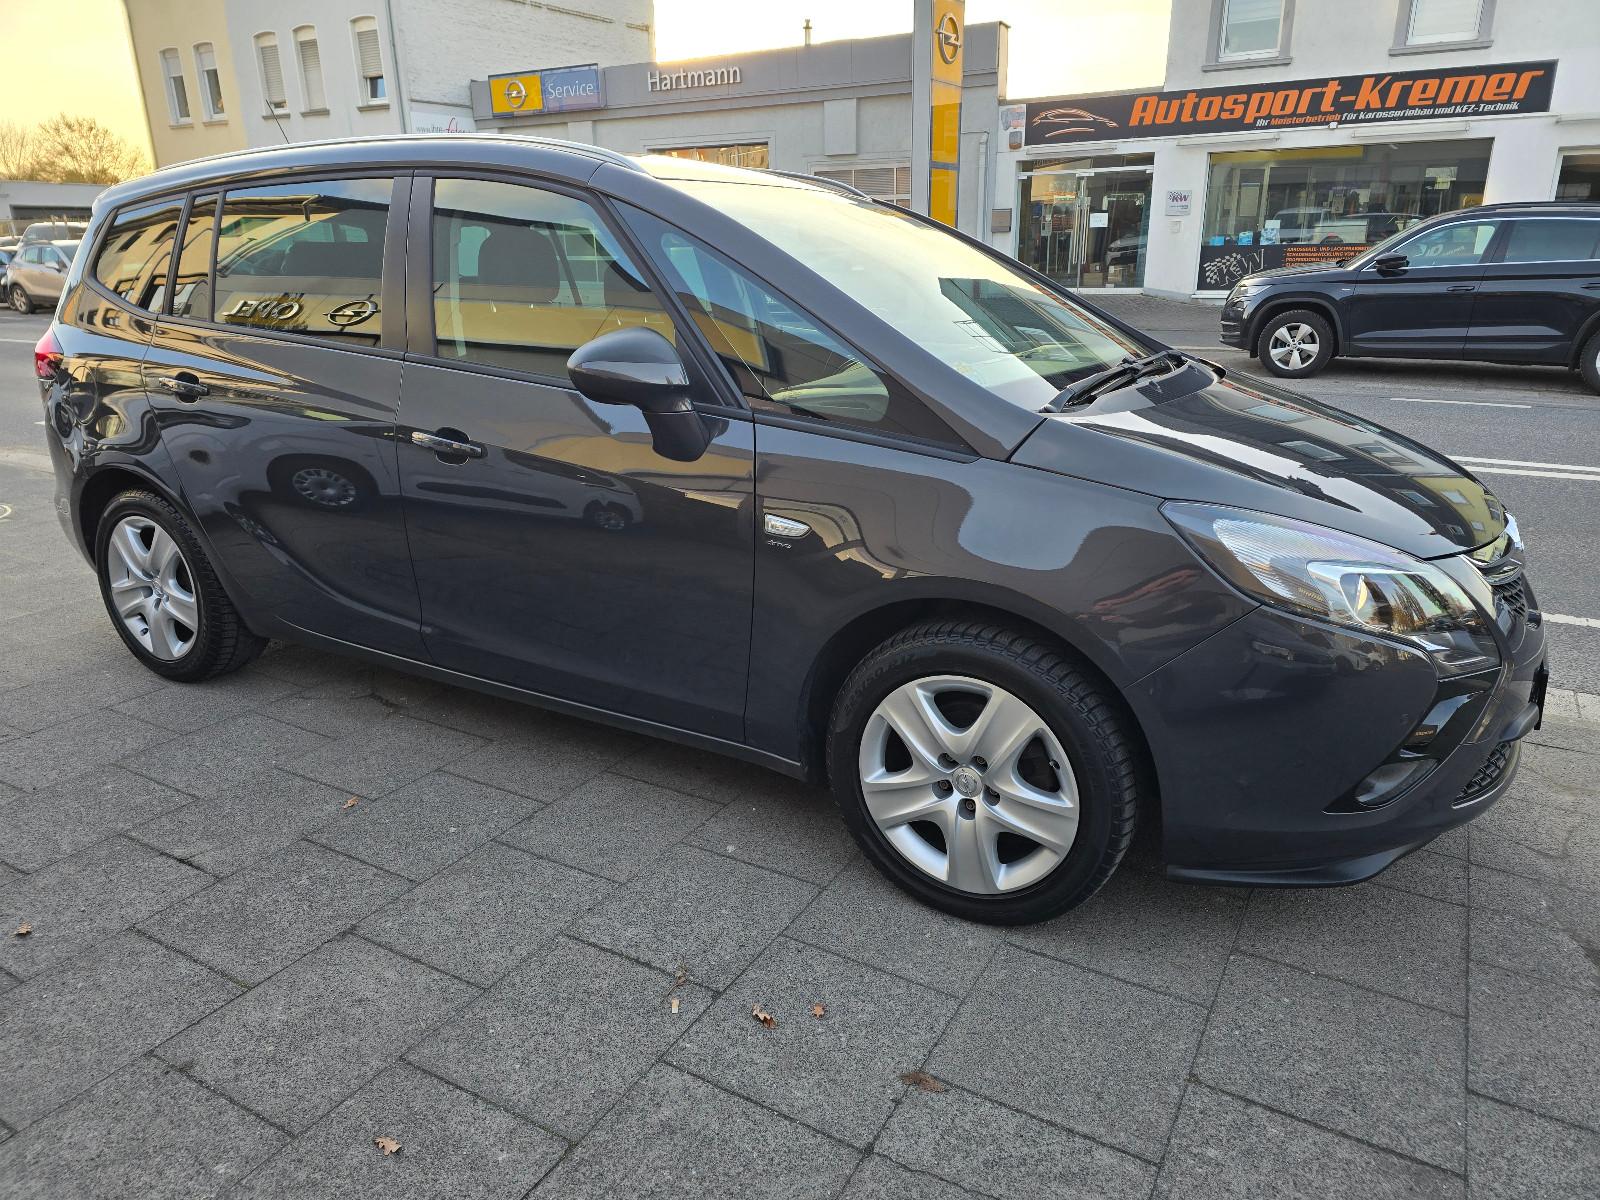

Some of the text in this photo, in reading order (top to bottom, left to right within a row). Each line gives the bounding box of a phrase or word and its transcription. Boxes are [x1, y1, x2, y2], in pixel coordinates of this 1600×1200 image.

[548, 80, 594, 99] Service
[647, 65, 741, 92] Hartmann
[1129, 70, 1545, 127] Autosport-Kremer
[1255, 101, 1519, 127] Ihr Meisterbetrieb für Karosseriebau und KFZ-Technik
